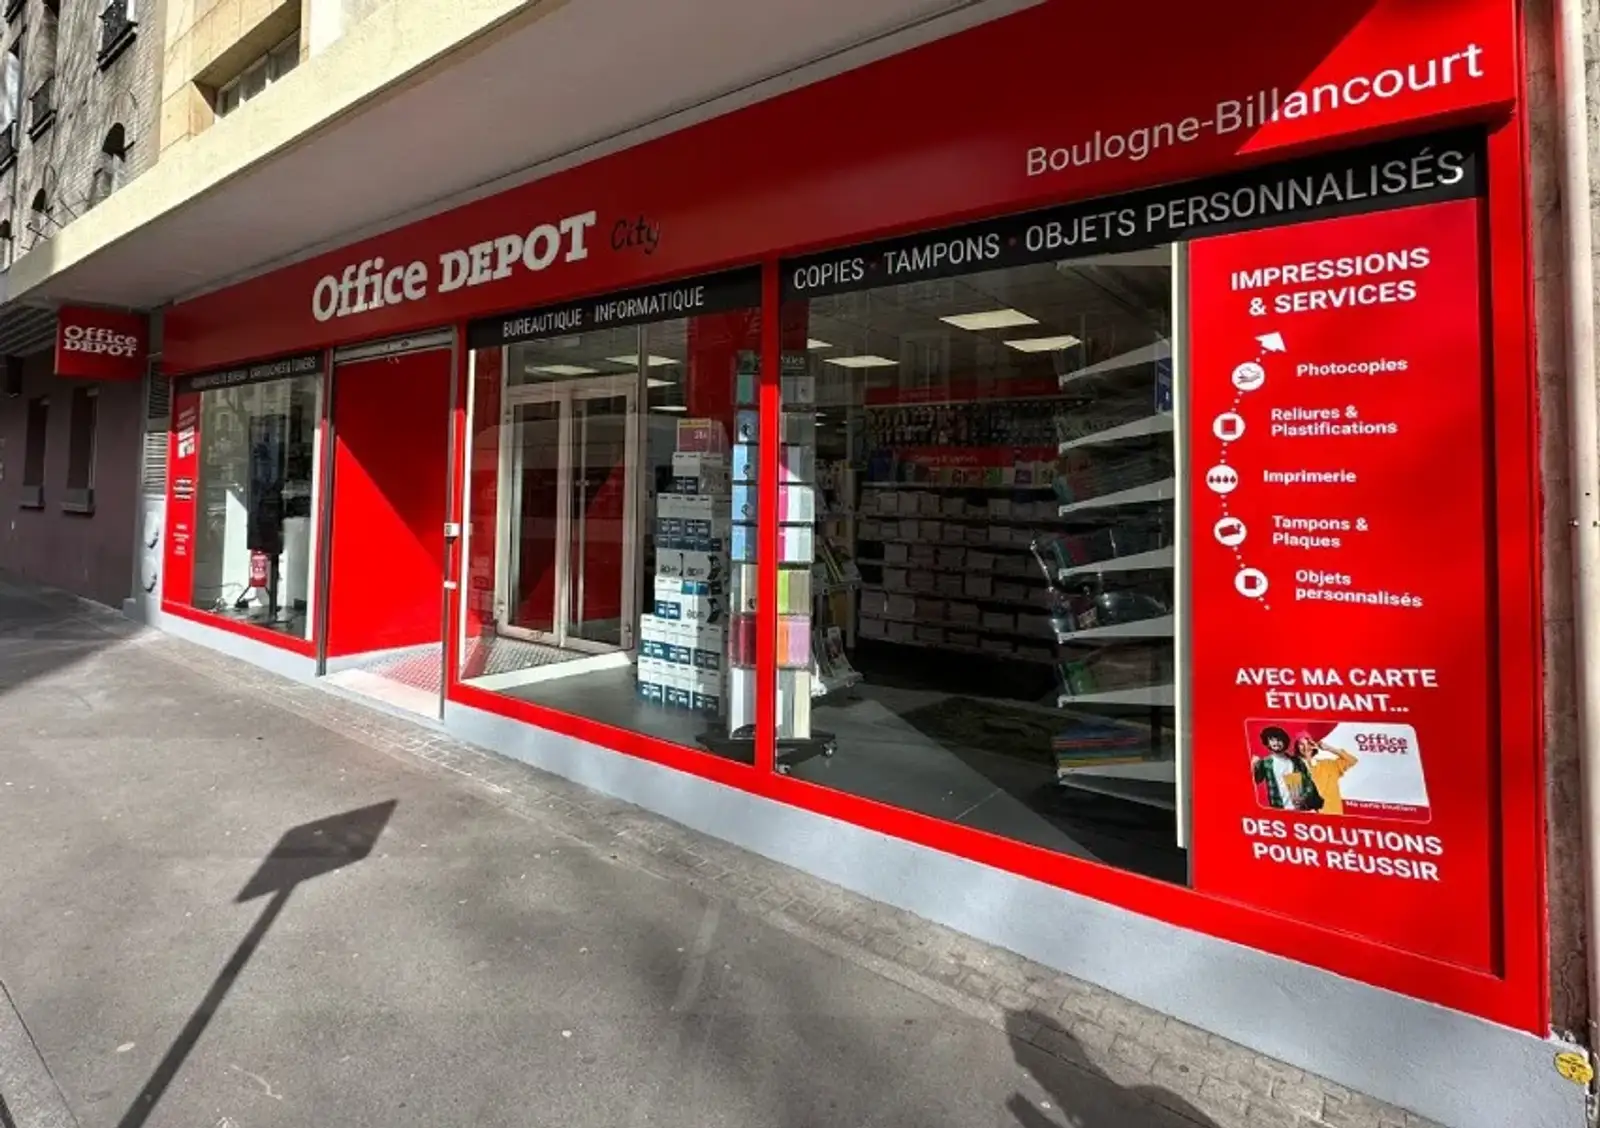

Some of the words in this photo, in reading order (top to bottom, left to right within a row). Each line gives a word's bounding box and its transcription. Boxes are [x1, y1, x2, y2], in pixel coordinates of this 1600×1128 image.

[1026, 43, 1484, 177] Boulogne-Billancourt
[793, 257, 865, 290] COPIES
[883, 233, 1000, 275] TAMPONS
[1025, 208, 1136, 252] OBJETS
[1145, 147, 1466, 231] PERSONNALISÉS
[312, 257, 428, 322] Office
[437, 211, 596, 293] DEPOT
[610, 215, 662, 255] City
[1231, 247, 1430, 291] IMPRESSIONS
[1249, 297, 1266, 316] &
[1274, 279, 1417, 314] SERVICES
[503, 308, 582, 338] BUREAUTIQUE
[594, 285, 705, 322] INFORMATIQUE
[64, 325, 137, 346] Office
[63, 339, 137, 357] DEPOT
[1296, 357, 1409, 377] Photocopies
[1271, 408, 1340, 422] Reliures
[1345, 405, 1358, 419] &
[1271, 420, 1398, 437] Plastifications
[1263, 469, 1357, 484] Imprimerie
[1272, 515, 1351, 533] Tampons
[1356, 518, 1368, 532] &
[1272, 533, 1341, 549] Plaques
[1295, 570, 1352, 586] Objets
[1295, 587, 1423, 607] personnalisés
[1235, 667, 1296, 686] AVEC
[1302, 669, 1343, 687] MA
[1349, 668, 1438, 688] CARTE
[1266, 689, 1409, 712] ÉTUDIANT...
[1355, 733, 1408, 746] Office
[1242, 818, 1287, 838] DES
[1293, 823, 1443, 856] SOLUTIONS
[1253, 842, 1319, 866] POUR
[1327, 849, 1440, 881] RÉUSSIR
